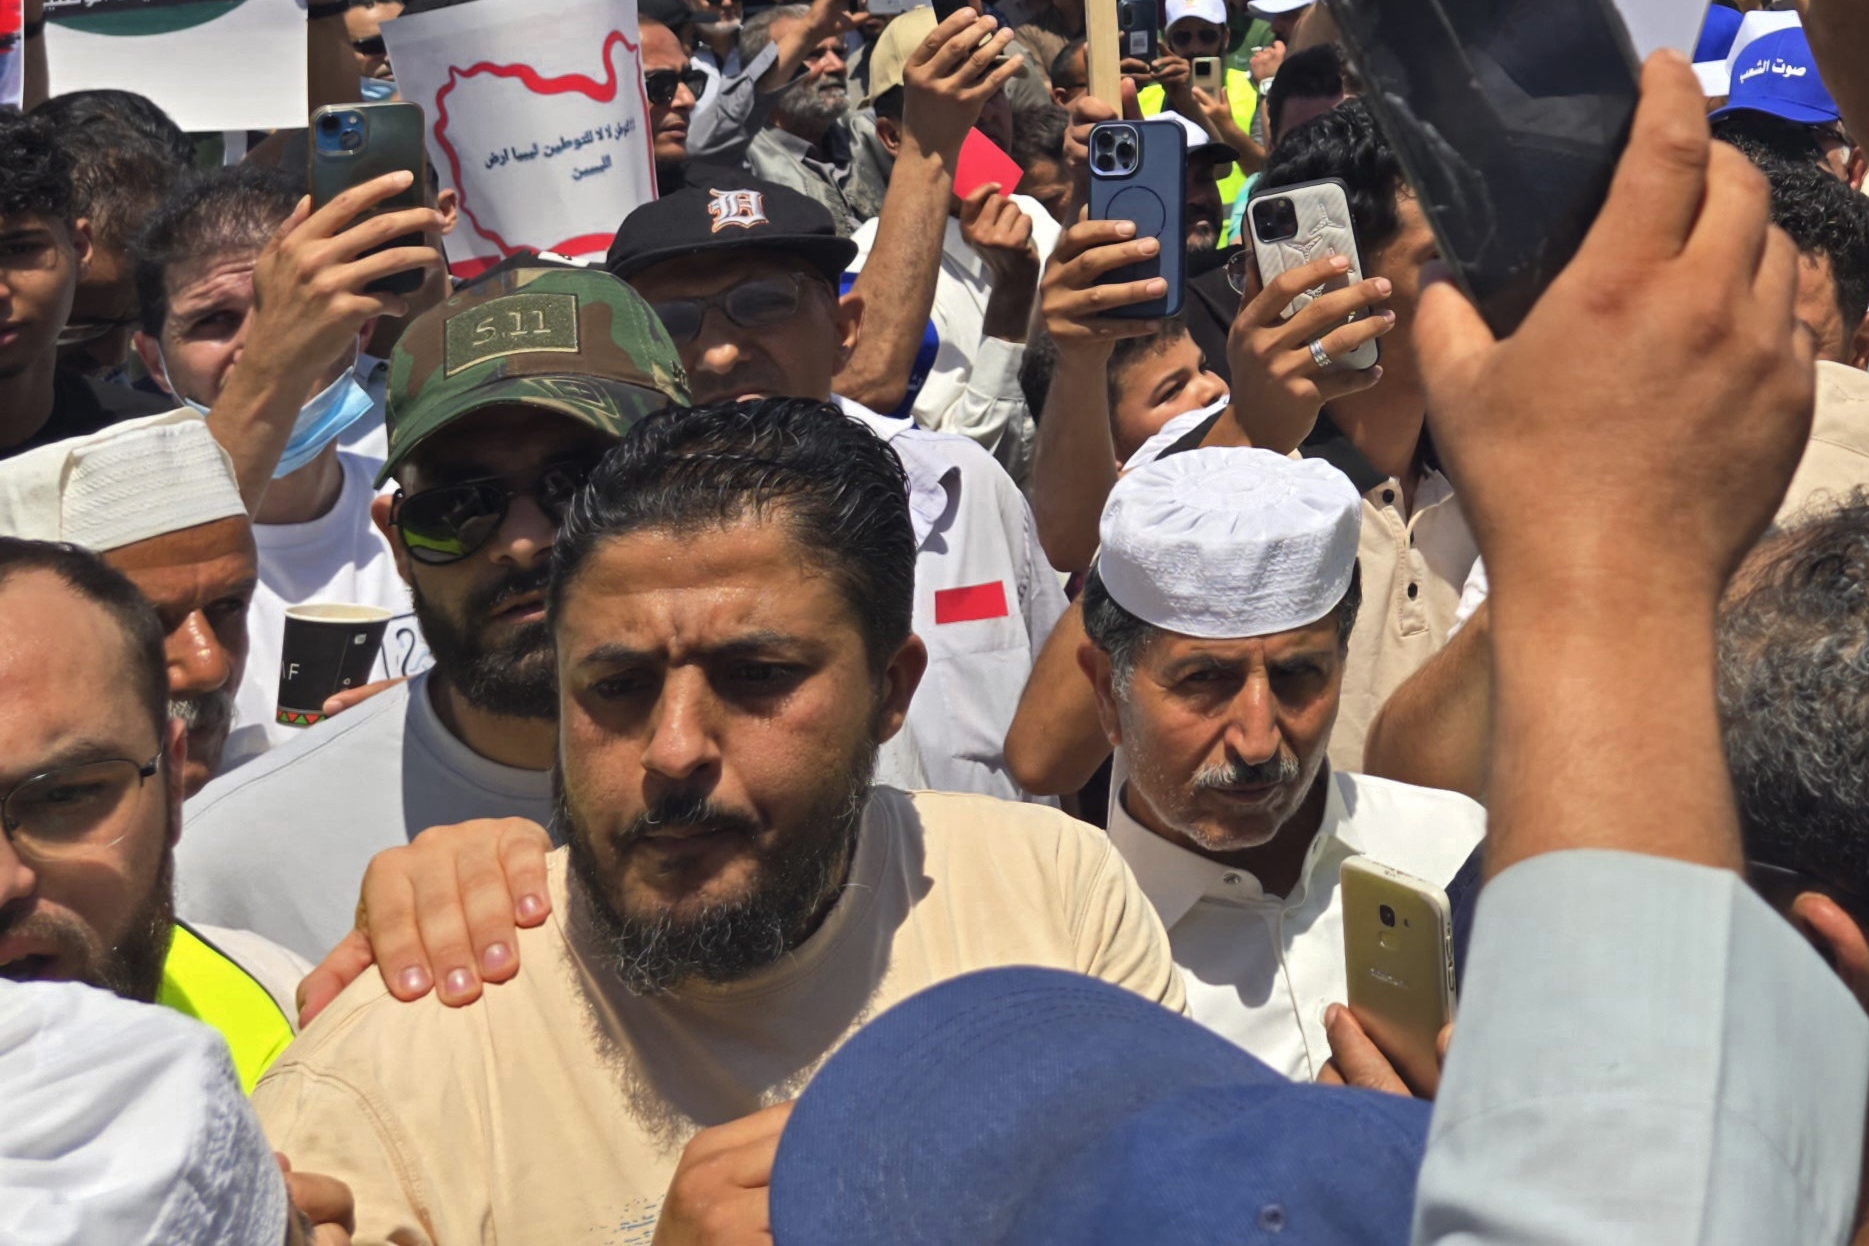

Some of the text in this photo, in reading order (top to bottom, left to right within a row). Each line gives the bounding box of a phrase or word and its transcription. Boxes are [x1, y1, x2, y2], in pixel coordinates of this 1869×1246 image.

[1740, 58, 1806, 84] صوت الشعب
[472, 309, 552, 347] 5.11
